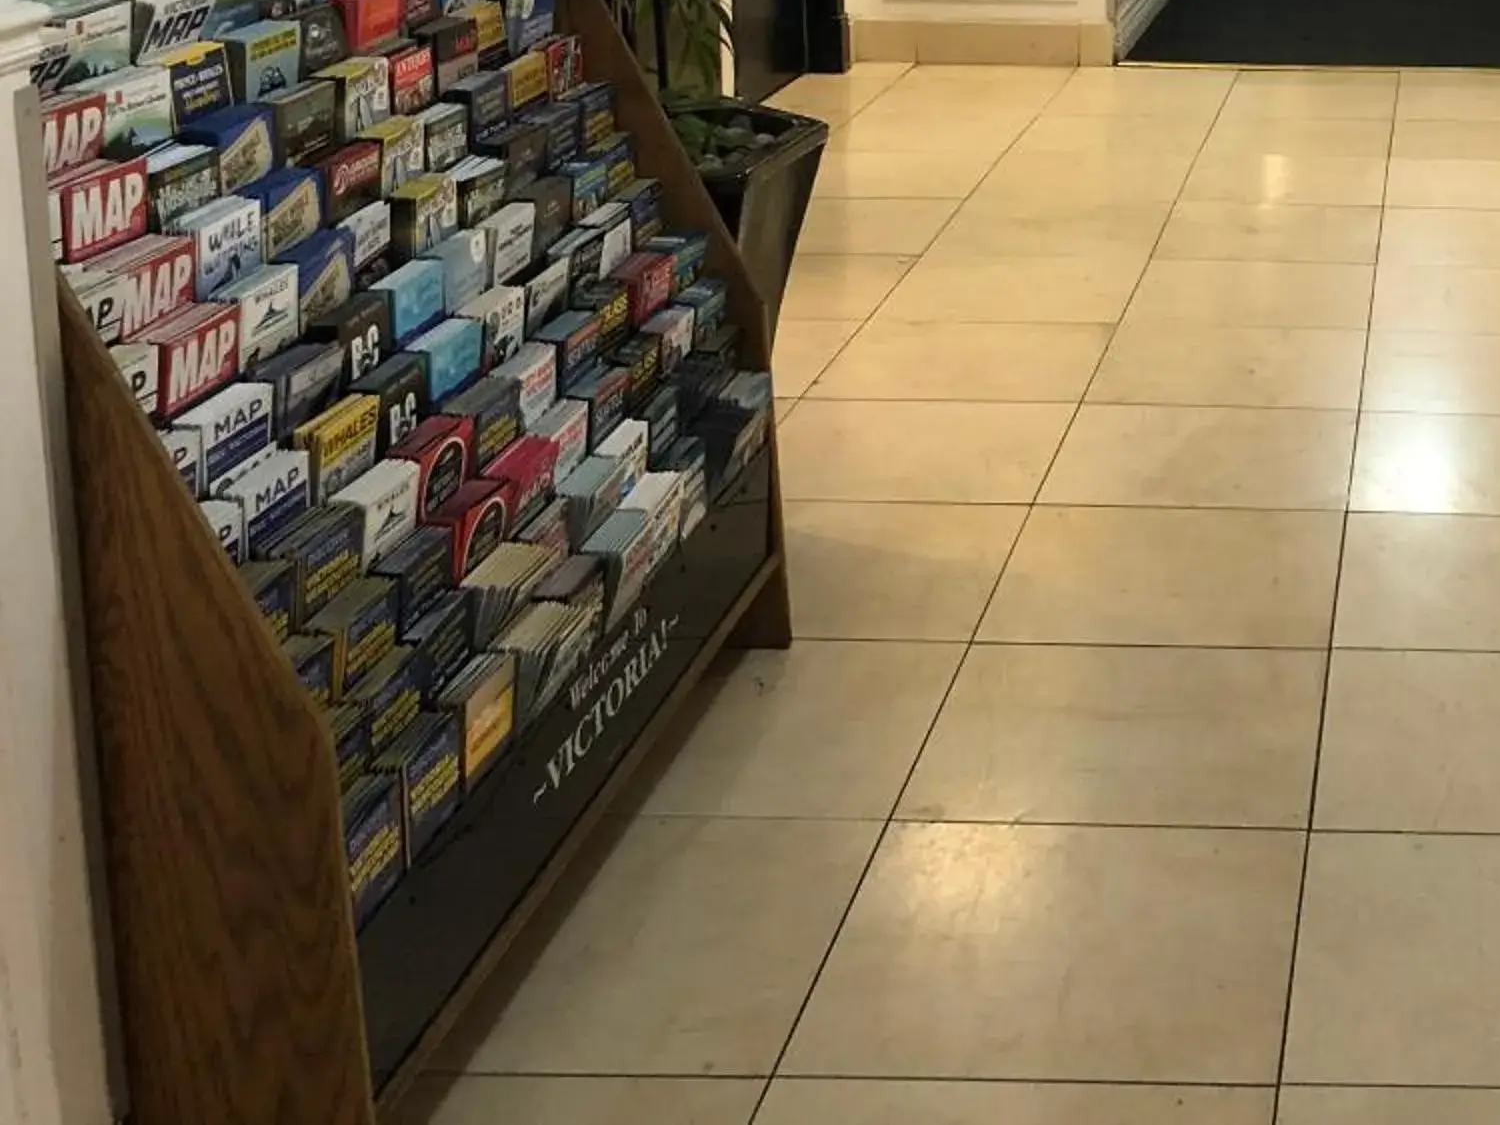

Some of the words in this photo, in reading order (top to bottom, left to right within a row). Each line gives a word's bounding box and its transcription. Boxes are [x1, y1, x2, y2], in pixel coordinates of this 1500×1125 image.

[142, 5, 211, 55] MAP
[71, 172, 144, 251] MAP
[122, 254, 193, 339] MAP
[168, 320, 237, 406] MAP
[213, 398, 263, 442] MAP
[322, 404, 378, 460] WHALES
[255, 467, 300, 513] MAP
[569, 629, 629, 711] Welcome
